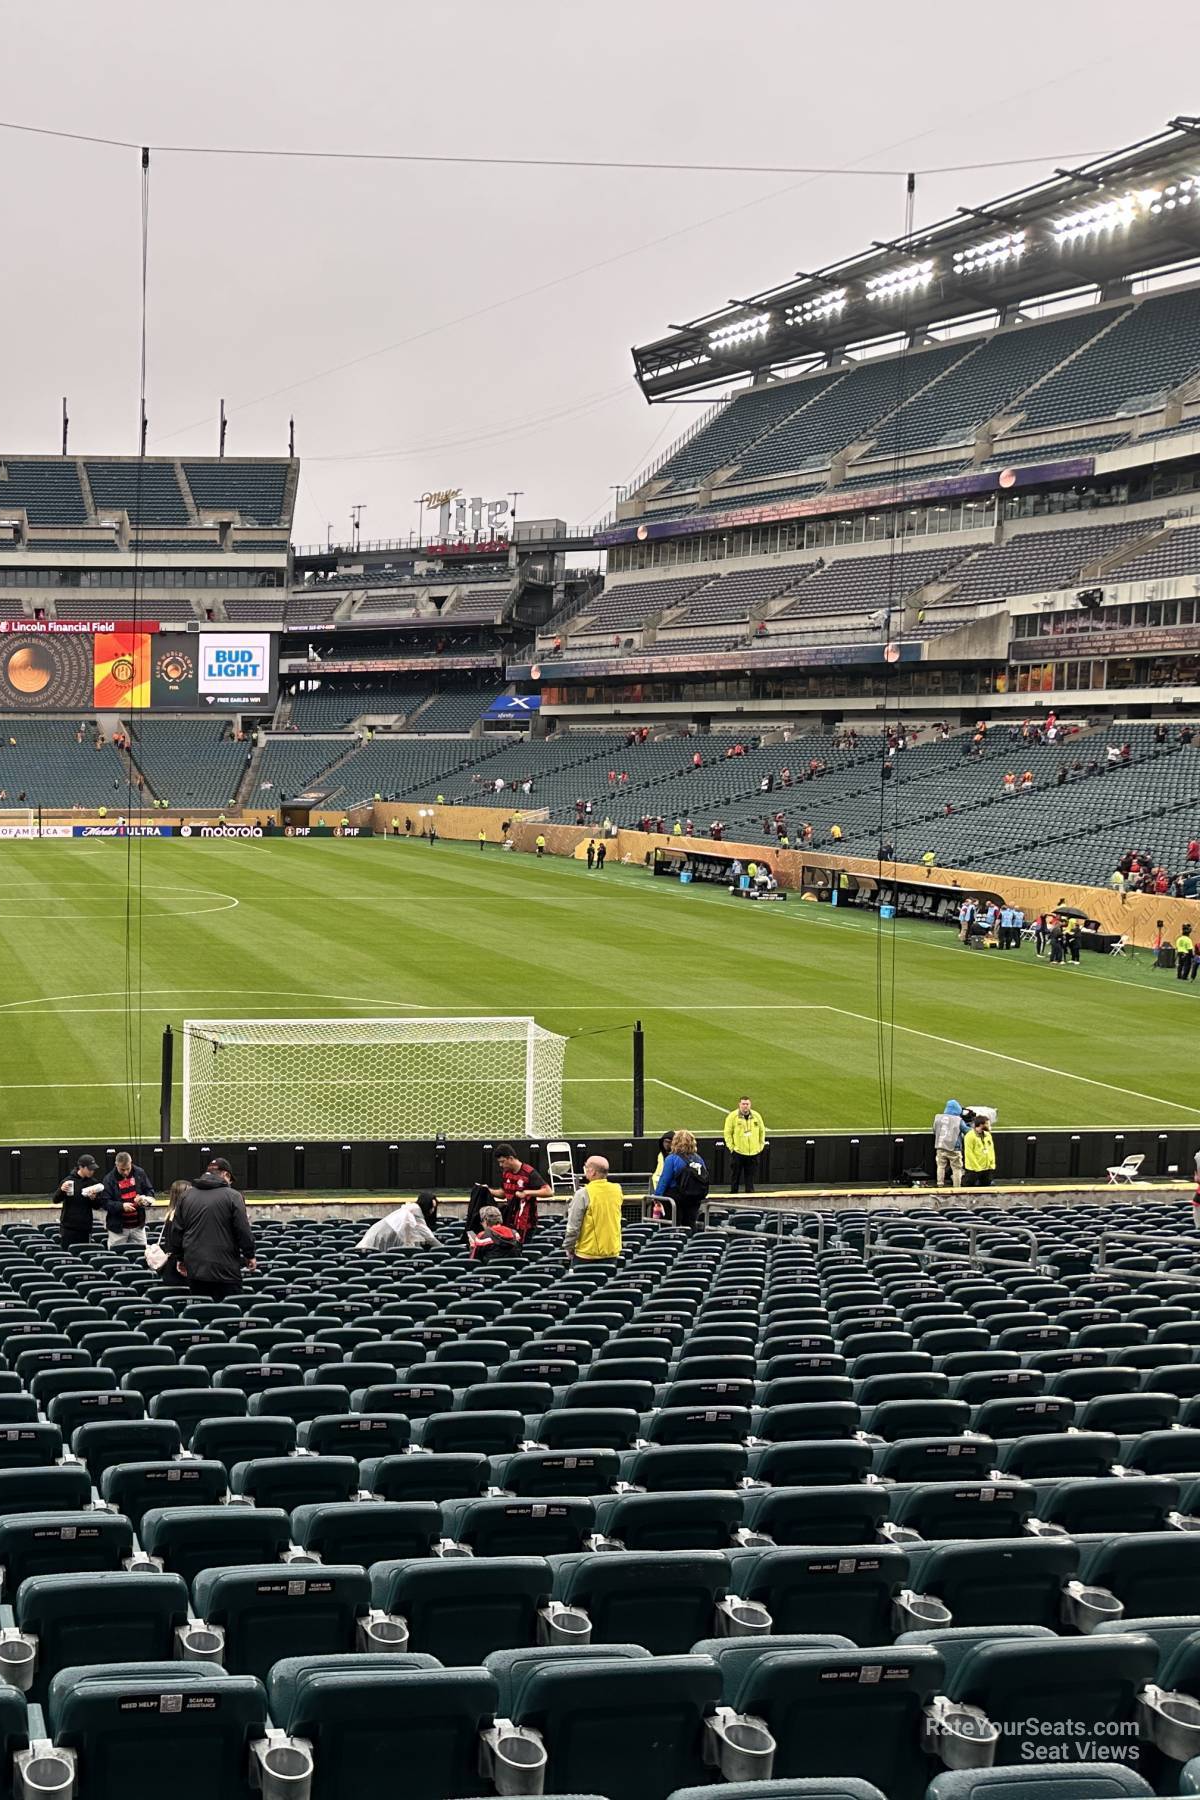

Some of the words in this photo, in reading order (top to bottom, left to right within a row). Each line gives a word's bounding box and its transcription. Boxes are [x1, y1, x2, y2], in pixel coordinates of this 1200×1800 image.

[422, 488, 462, 510] Miller
[435, 498, 508, 540] Lite
[12, 622, 46, 631] Lincoln
[48, 622, 90, 631] Financial
[92, 622, 114, 631] Field
[215, 650, 253, 663] BUD
[208, 664, 260, 677] LIGHT
[127, 827, 161, 835] ULTRA
[200, 826, 262, 837] motorola
[296, 828, 310, 836] PIF
